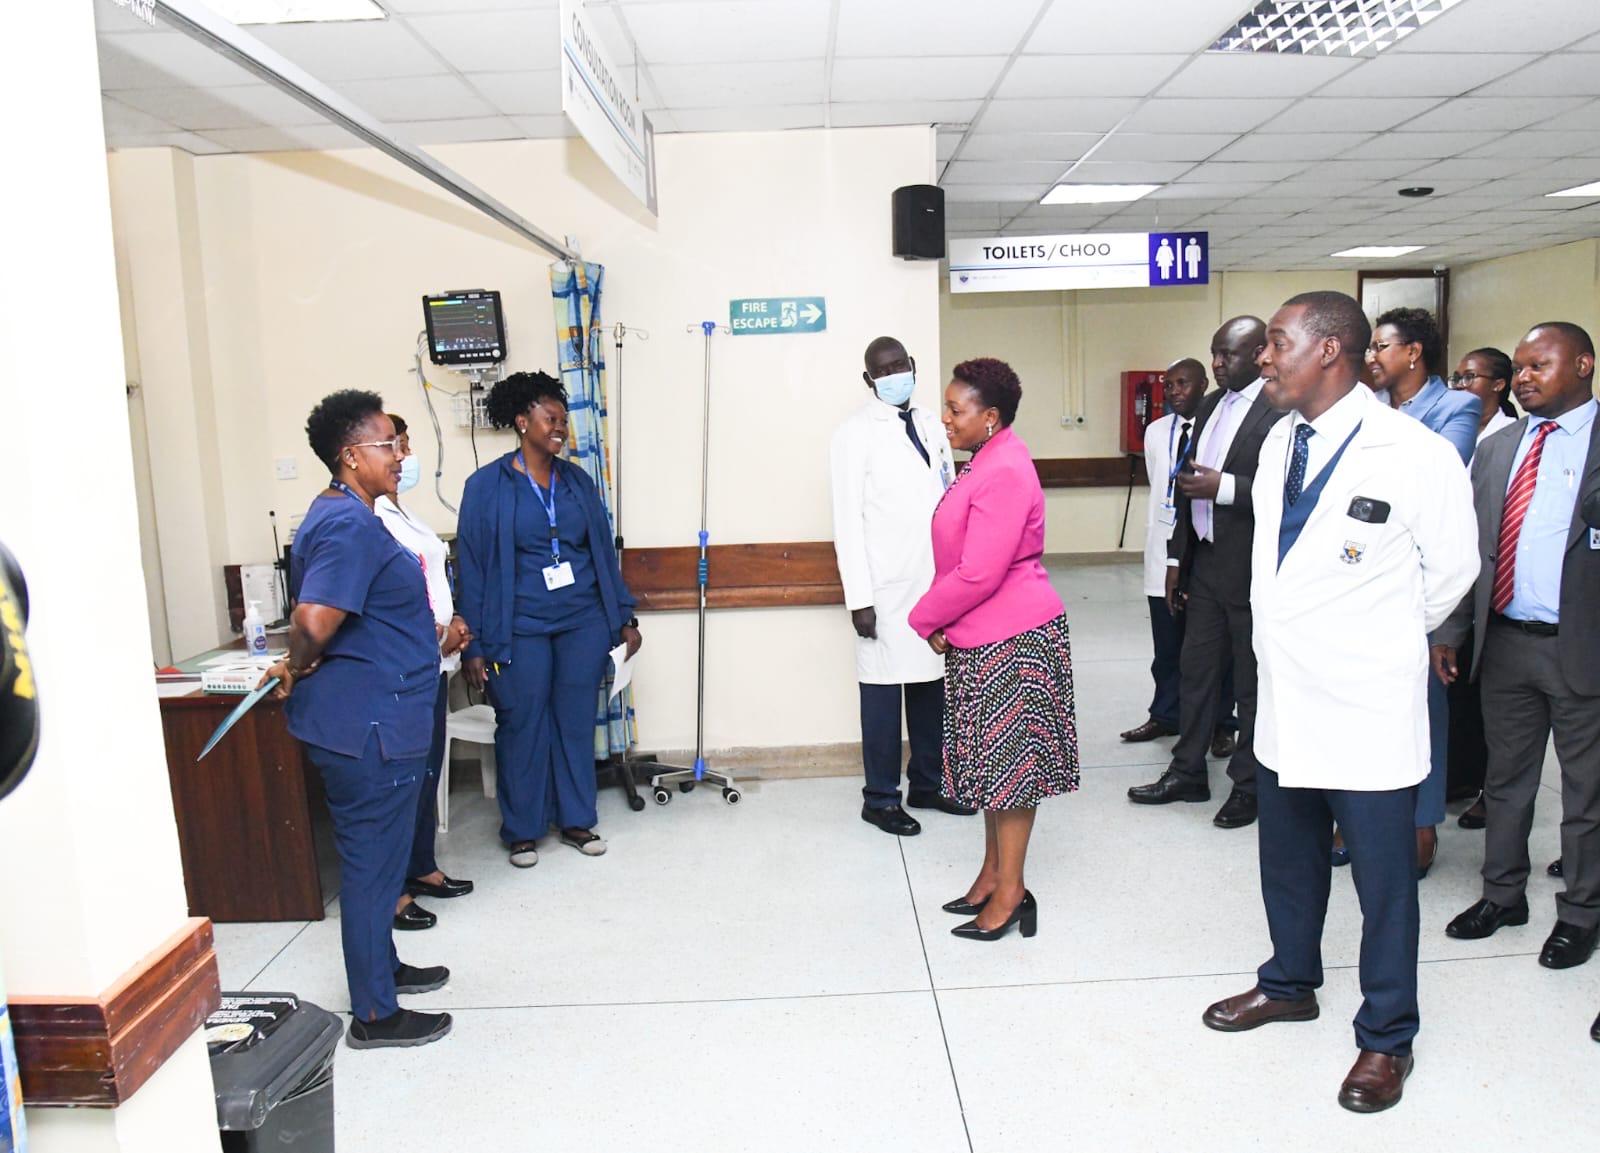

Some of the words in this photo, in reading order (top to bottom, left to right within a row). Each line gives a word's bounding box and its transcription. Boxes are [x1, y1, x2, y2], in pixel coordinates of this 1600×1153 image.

[573, 13, 618, 109] CONSULTATION
[742, 302, 768, 313] FIRE
[733, 317, 778, 329] ESCAPE
